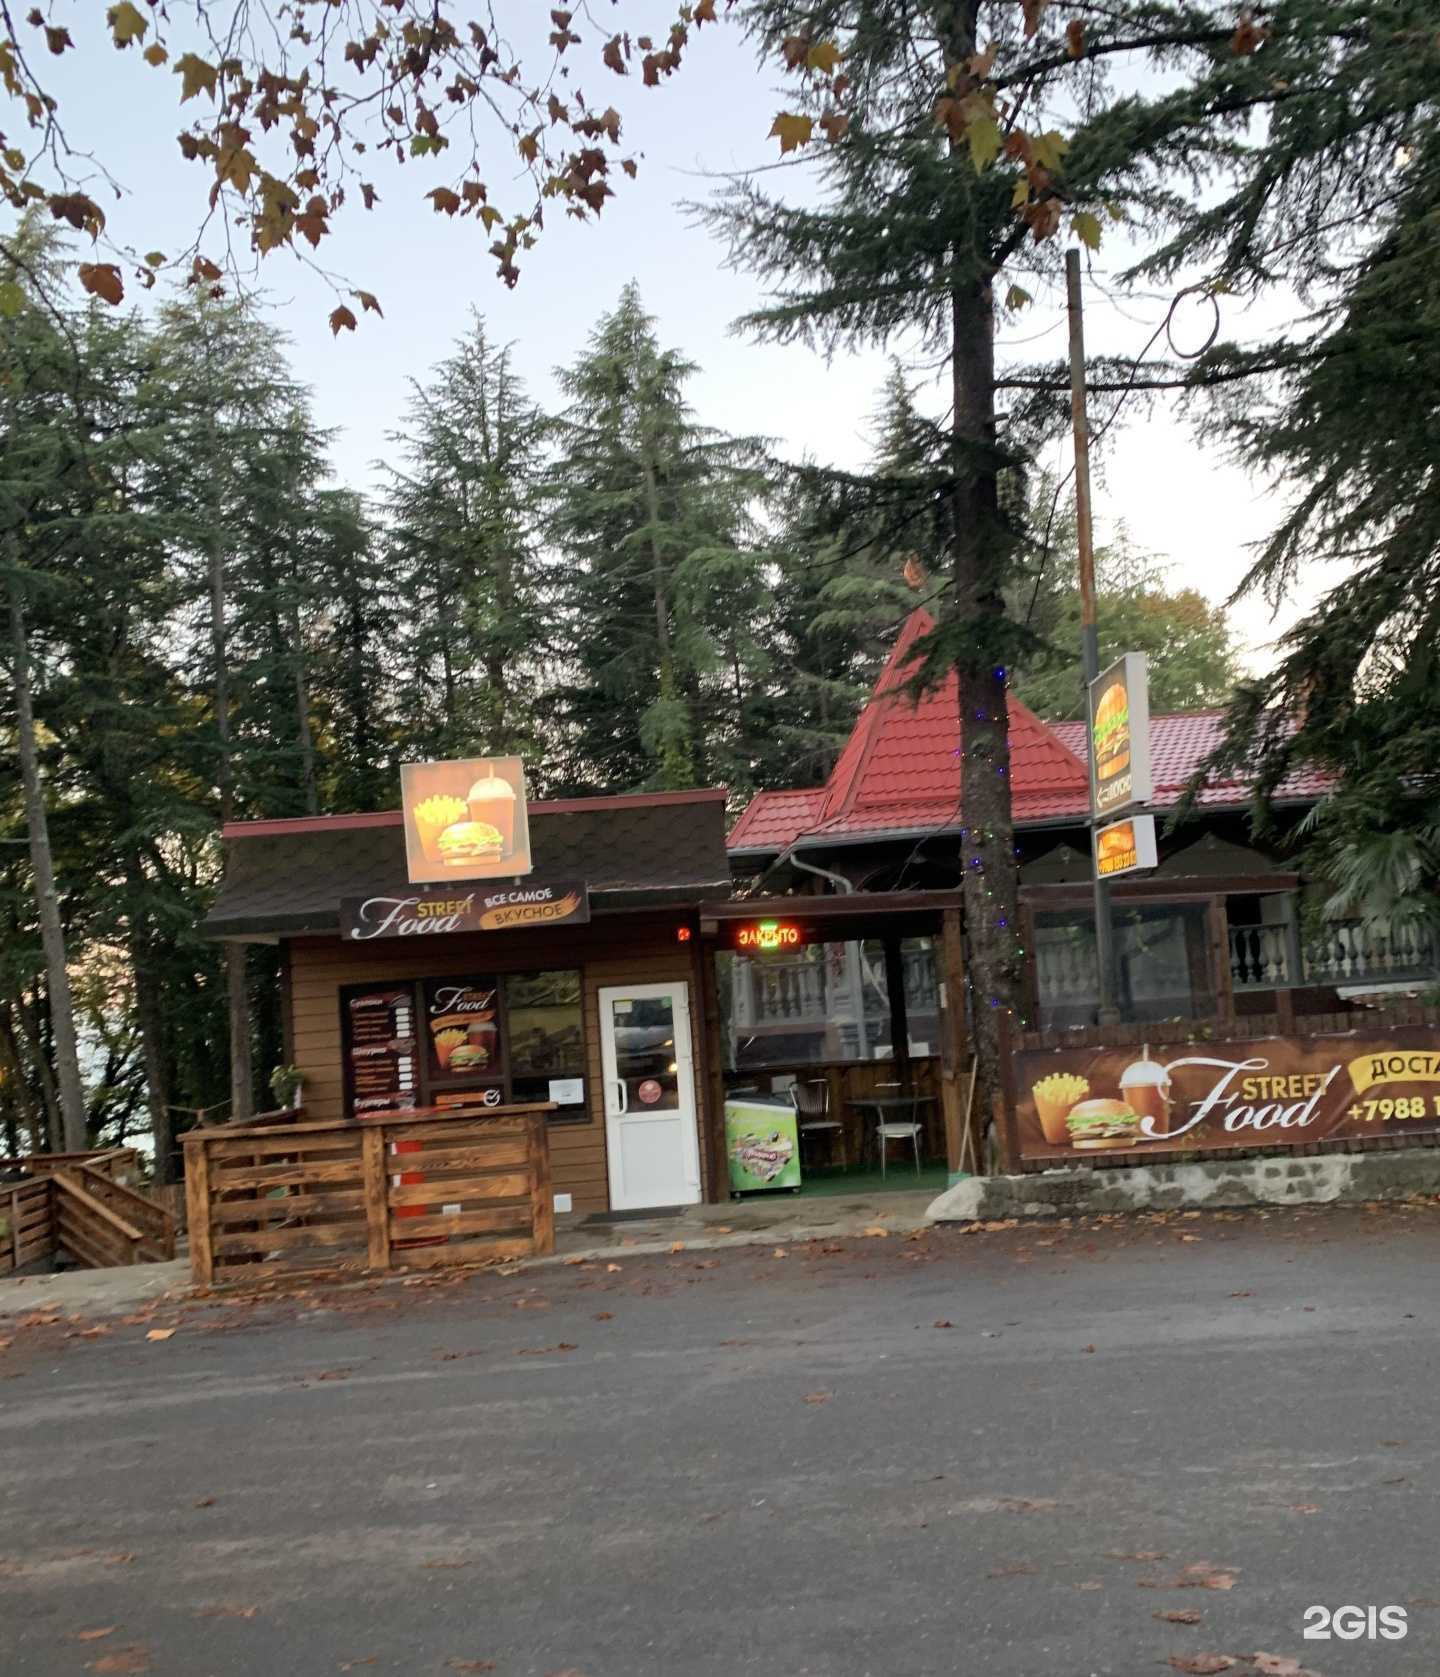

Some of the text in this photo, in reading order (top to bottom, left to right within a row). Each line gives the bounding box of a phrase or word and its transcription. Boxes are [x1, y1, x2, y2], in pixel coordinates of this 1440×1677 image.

[417, 900, 472, 918] STREET
[484, 887, 553, 908] ВСЕ САМОЕ
[351, 893, 475, 940] Food
[495, 904, 562, 925] ВКУСНОЕ
[430, 986, 497, 1014] Food
[1140, 1057, 1341, 1138] Food
[1242, 1073, 1329, 1100] STREET
[1347, 1096, 1426, 1121] +7988
